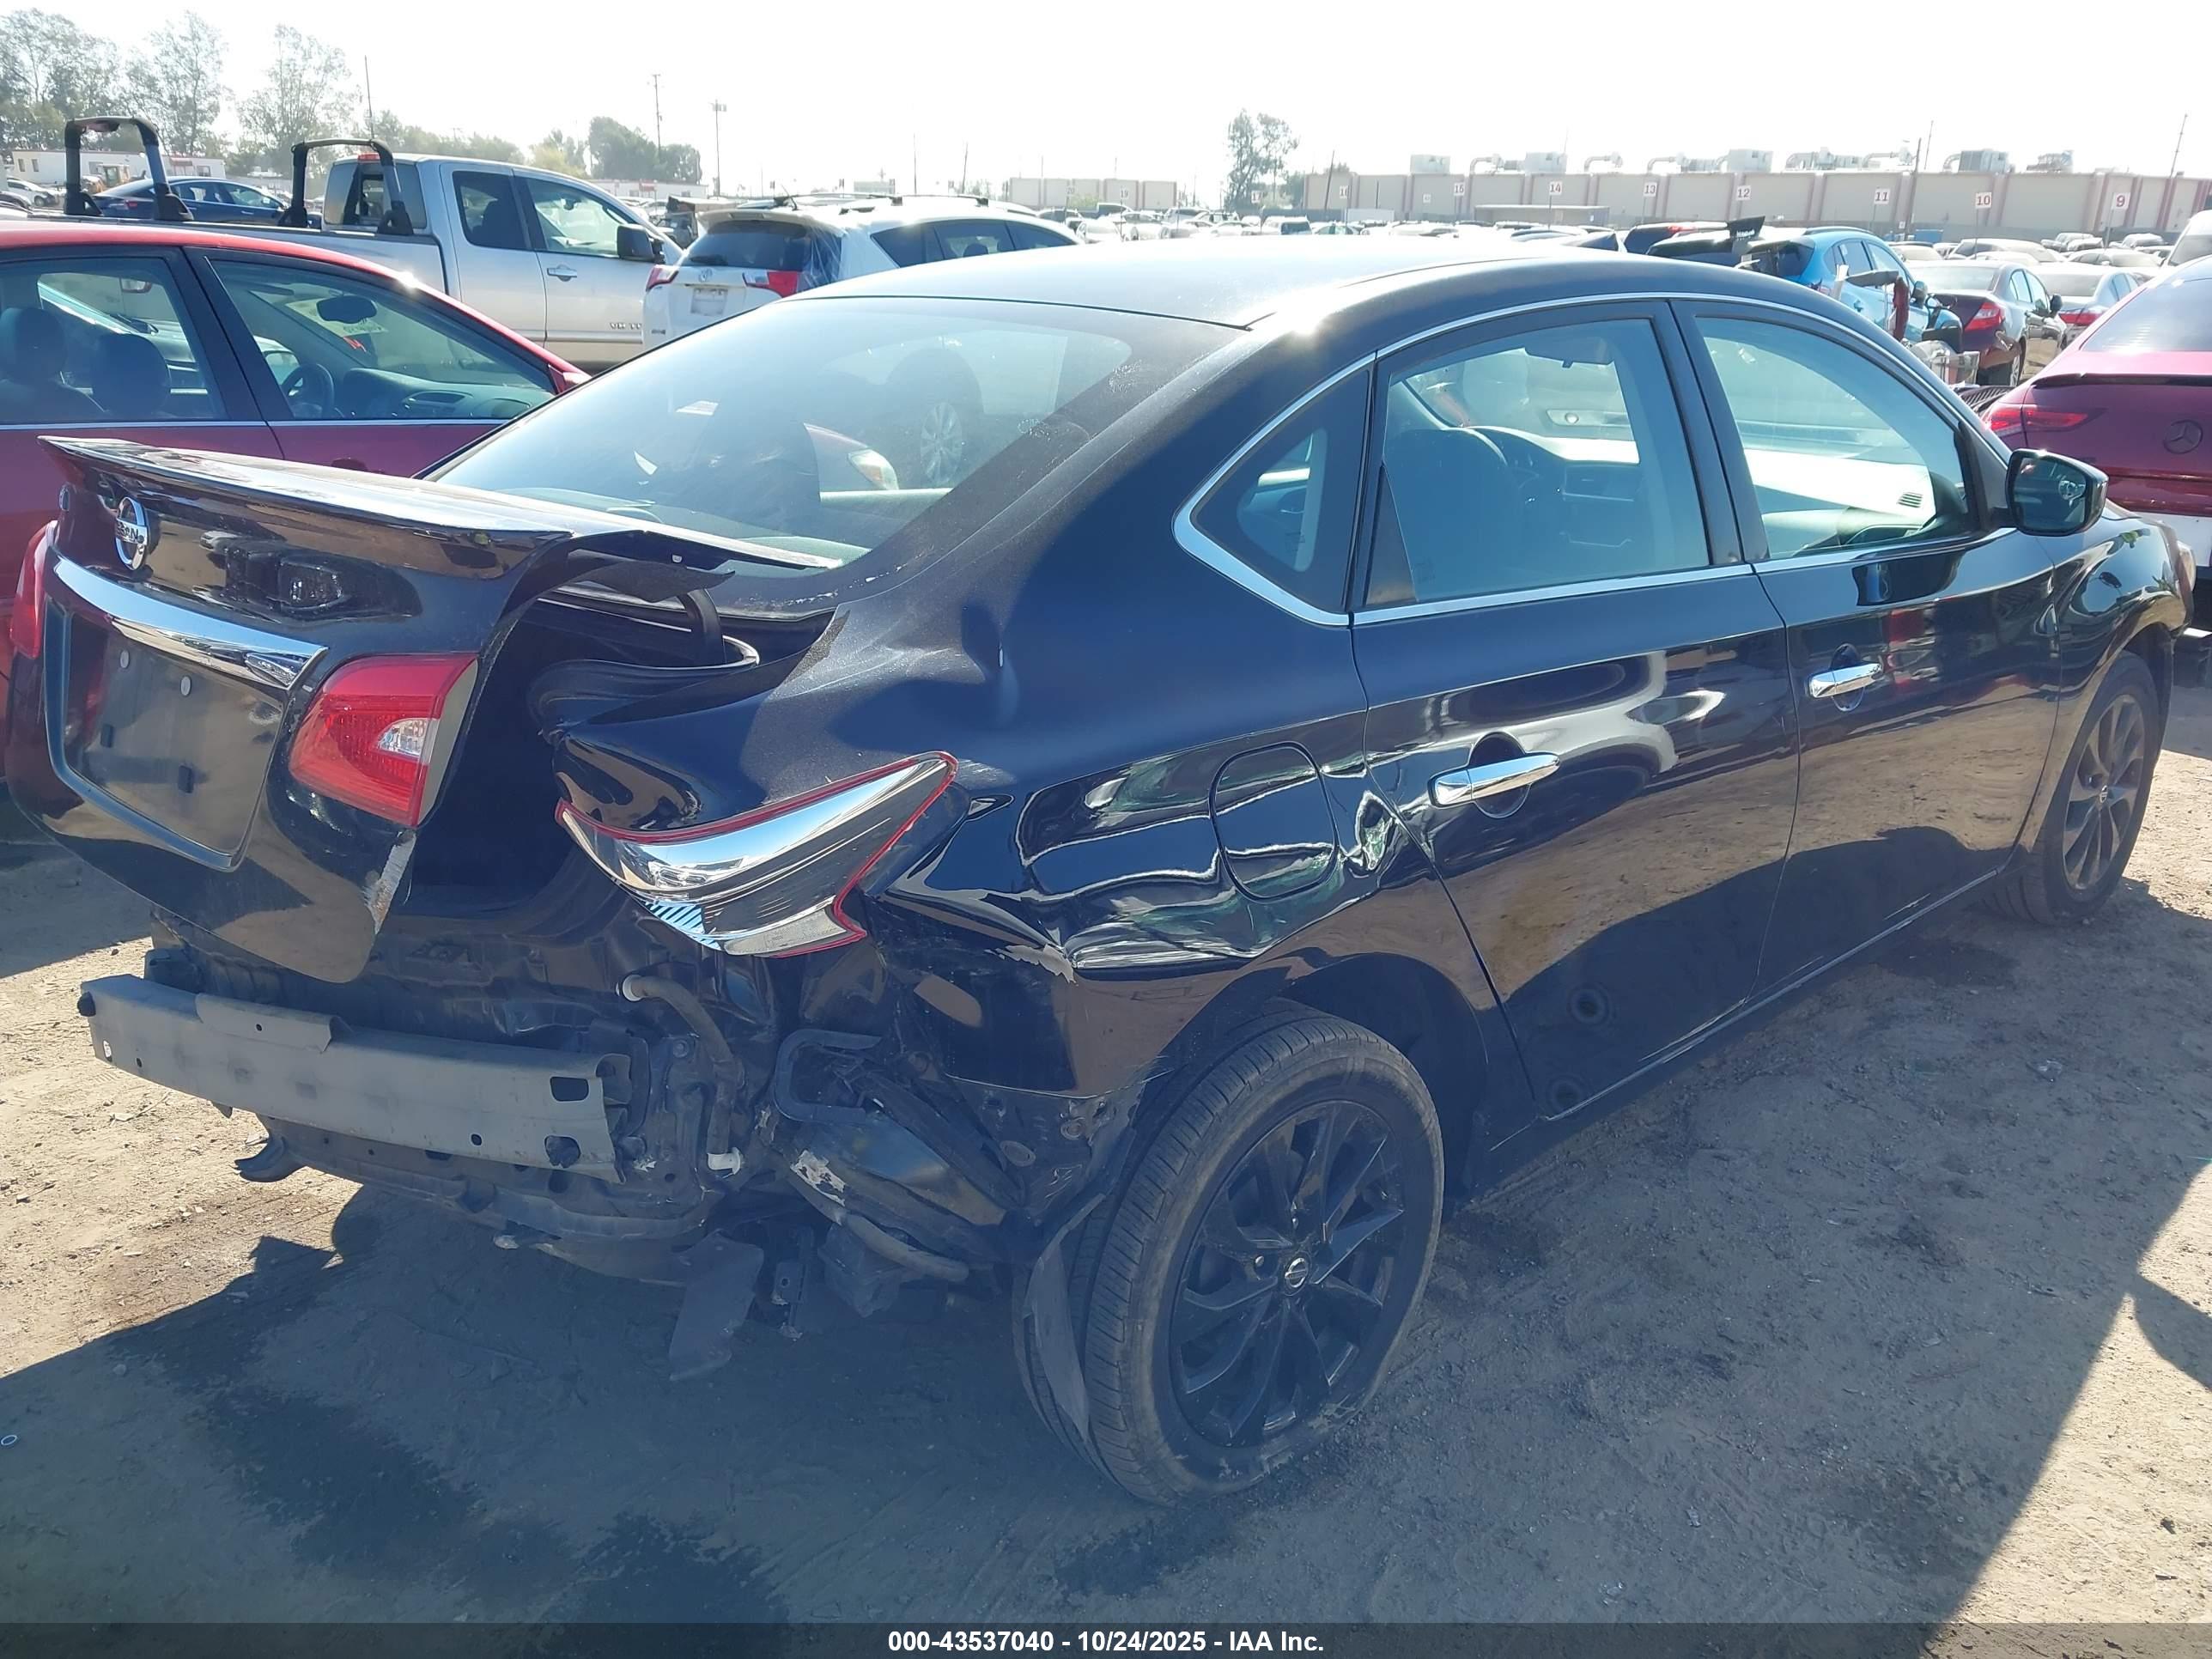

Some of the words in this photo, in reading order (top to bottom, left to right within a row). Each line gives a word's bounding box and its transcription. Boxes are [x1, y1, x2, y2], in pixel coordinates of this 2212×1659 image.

[1550, 183, 1561, 193] 14
[1644, 185, 1656, 194] 13
[1737, 188, 1750, 198] 12
[1875, 191, 1888, 202] 11
[1977, 195, 1990, 206] 10
[2115, 194, 2126, 208] 9
